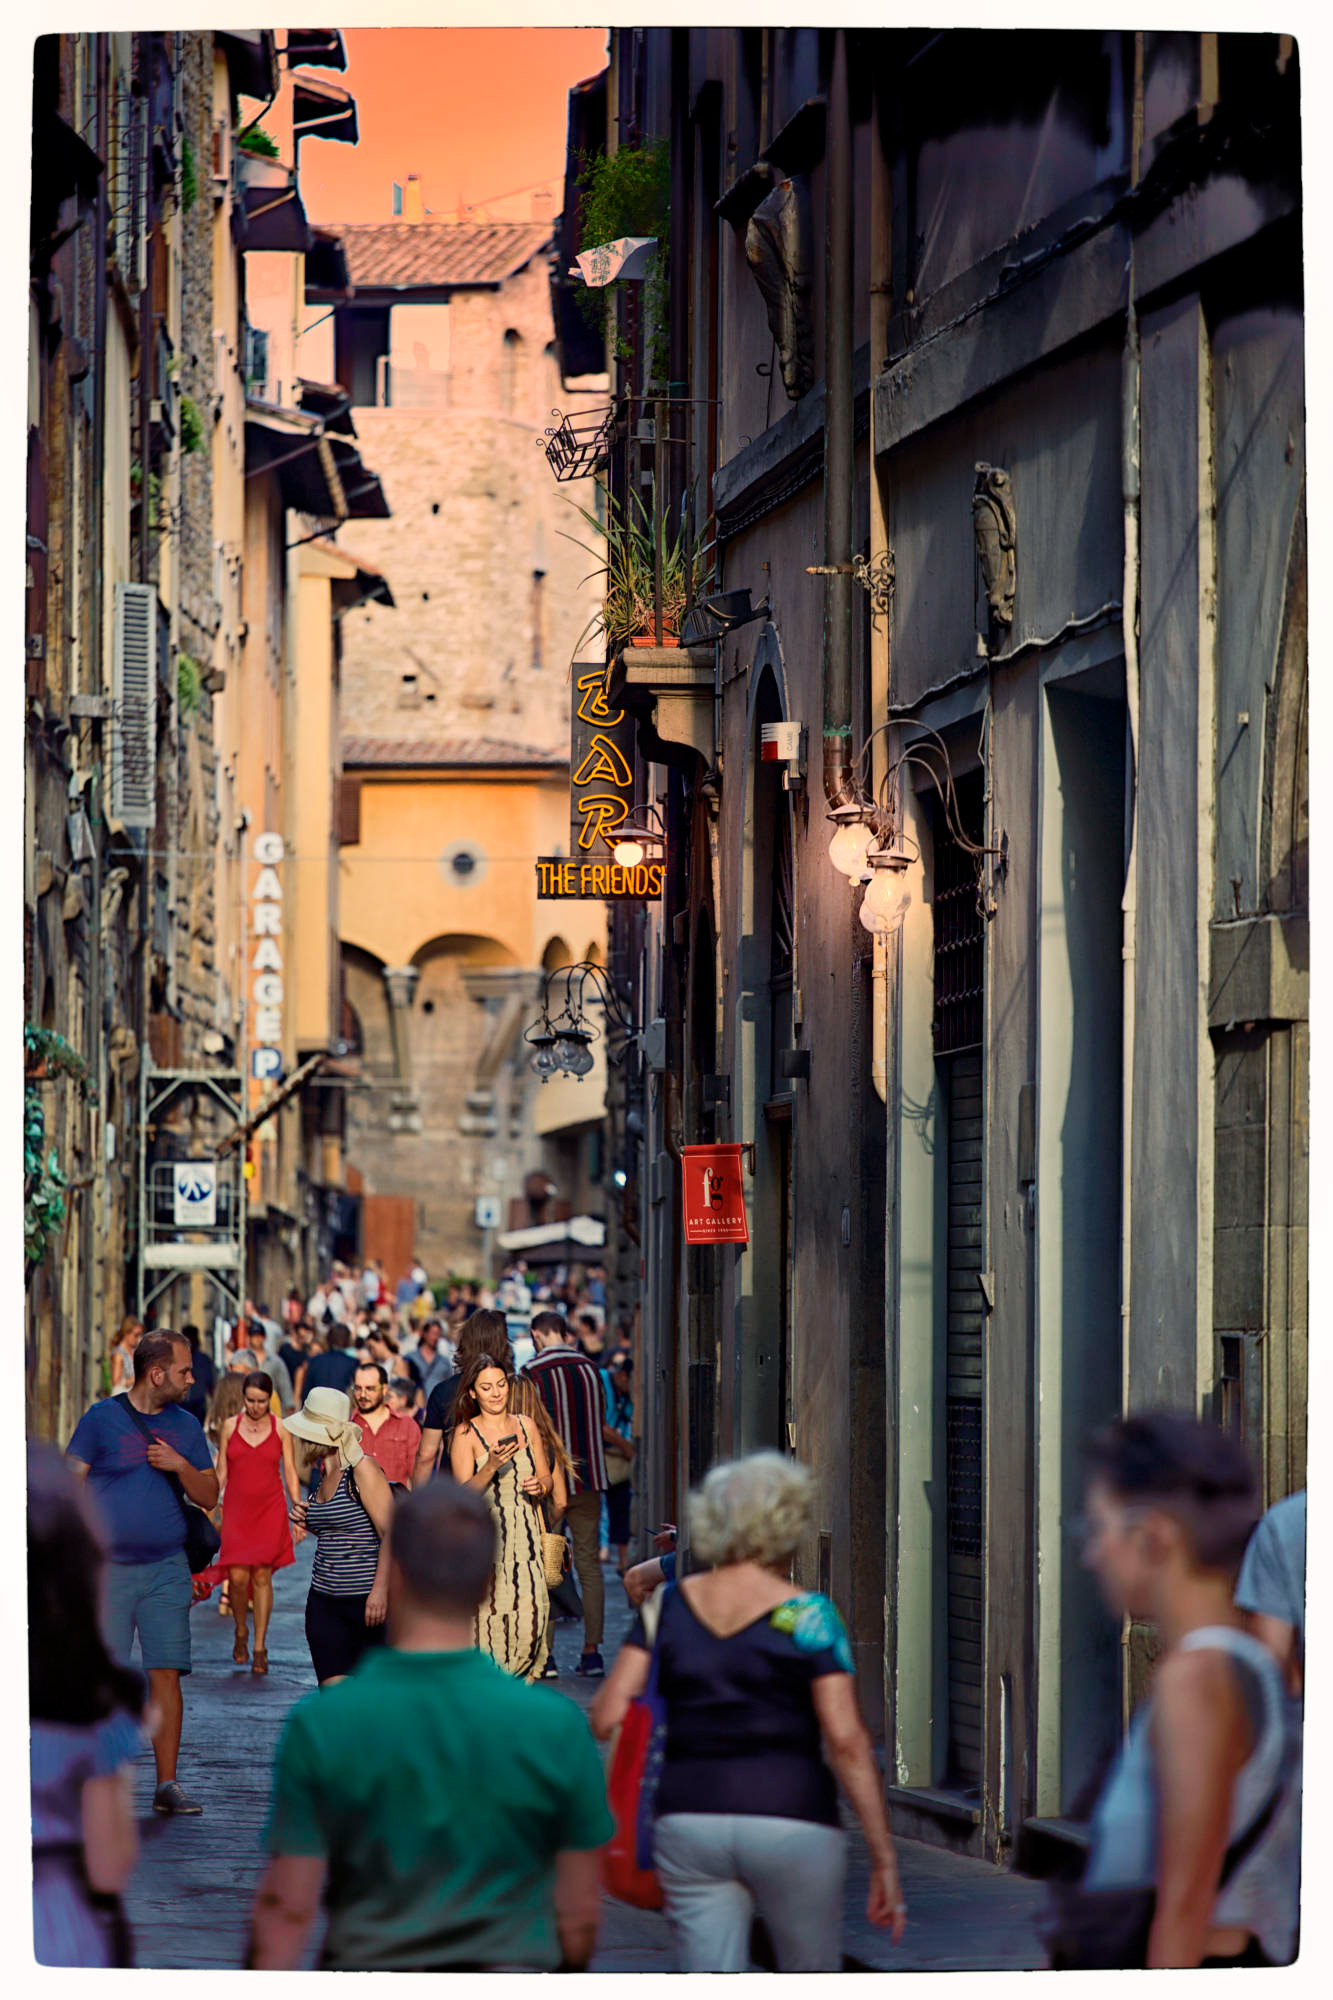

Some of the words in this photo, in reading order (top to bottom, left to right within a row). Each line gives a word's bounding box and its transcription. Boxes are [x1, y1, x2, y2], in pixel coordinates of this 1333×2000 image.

[537, 863, 577, 895] THE
[252, 832, 284, 1042] GARAGE
[254, 1050, 279, 1078] P
[705, 1217, 742, 1225] GALLERY
